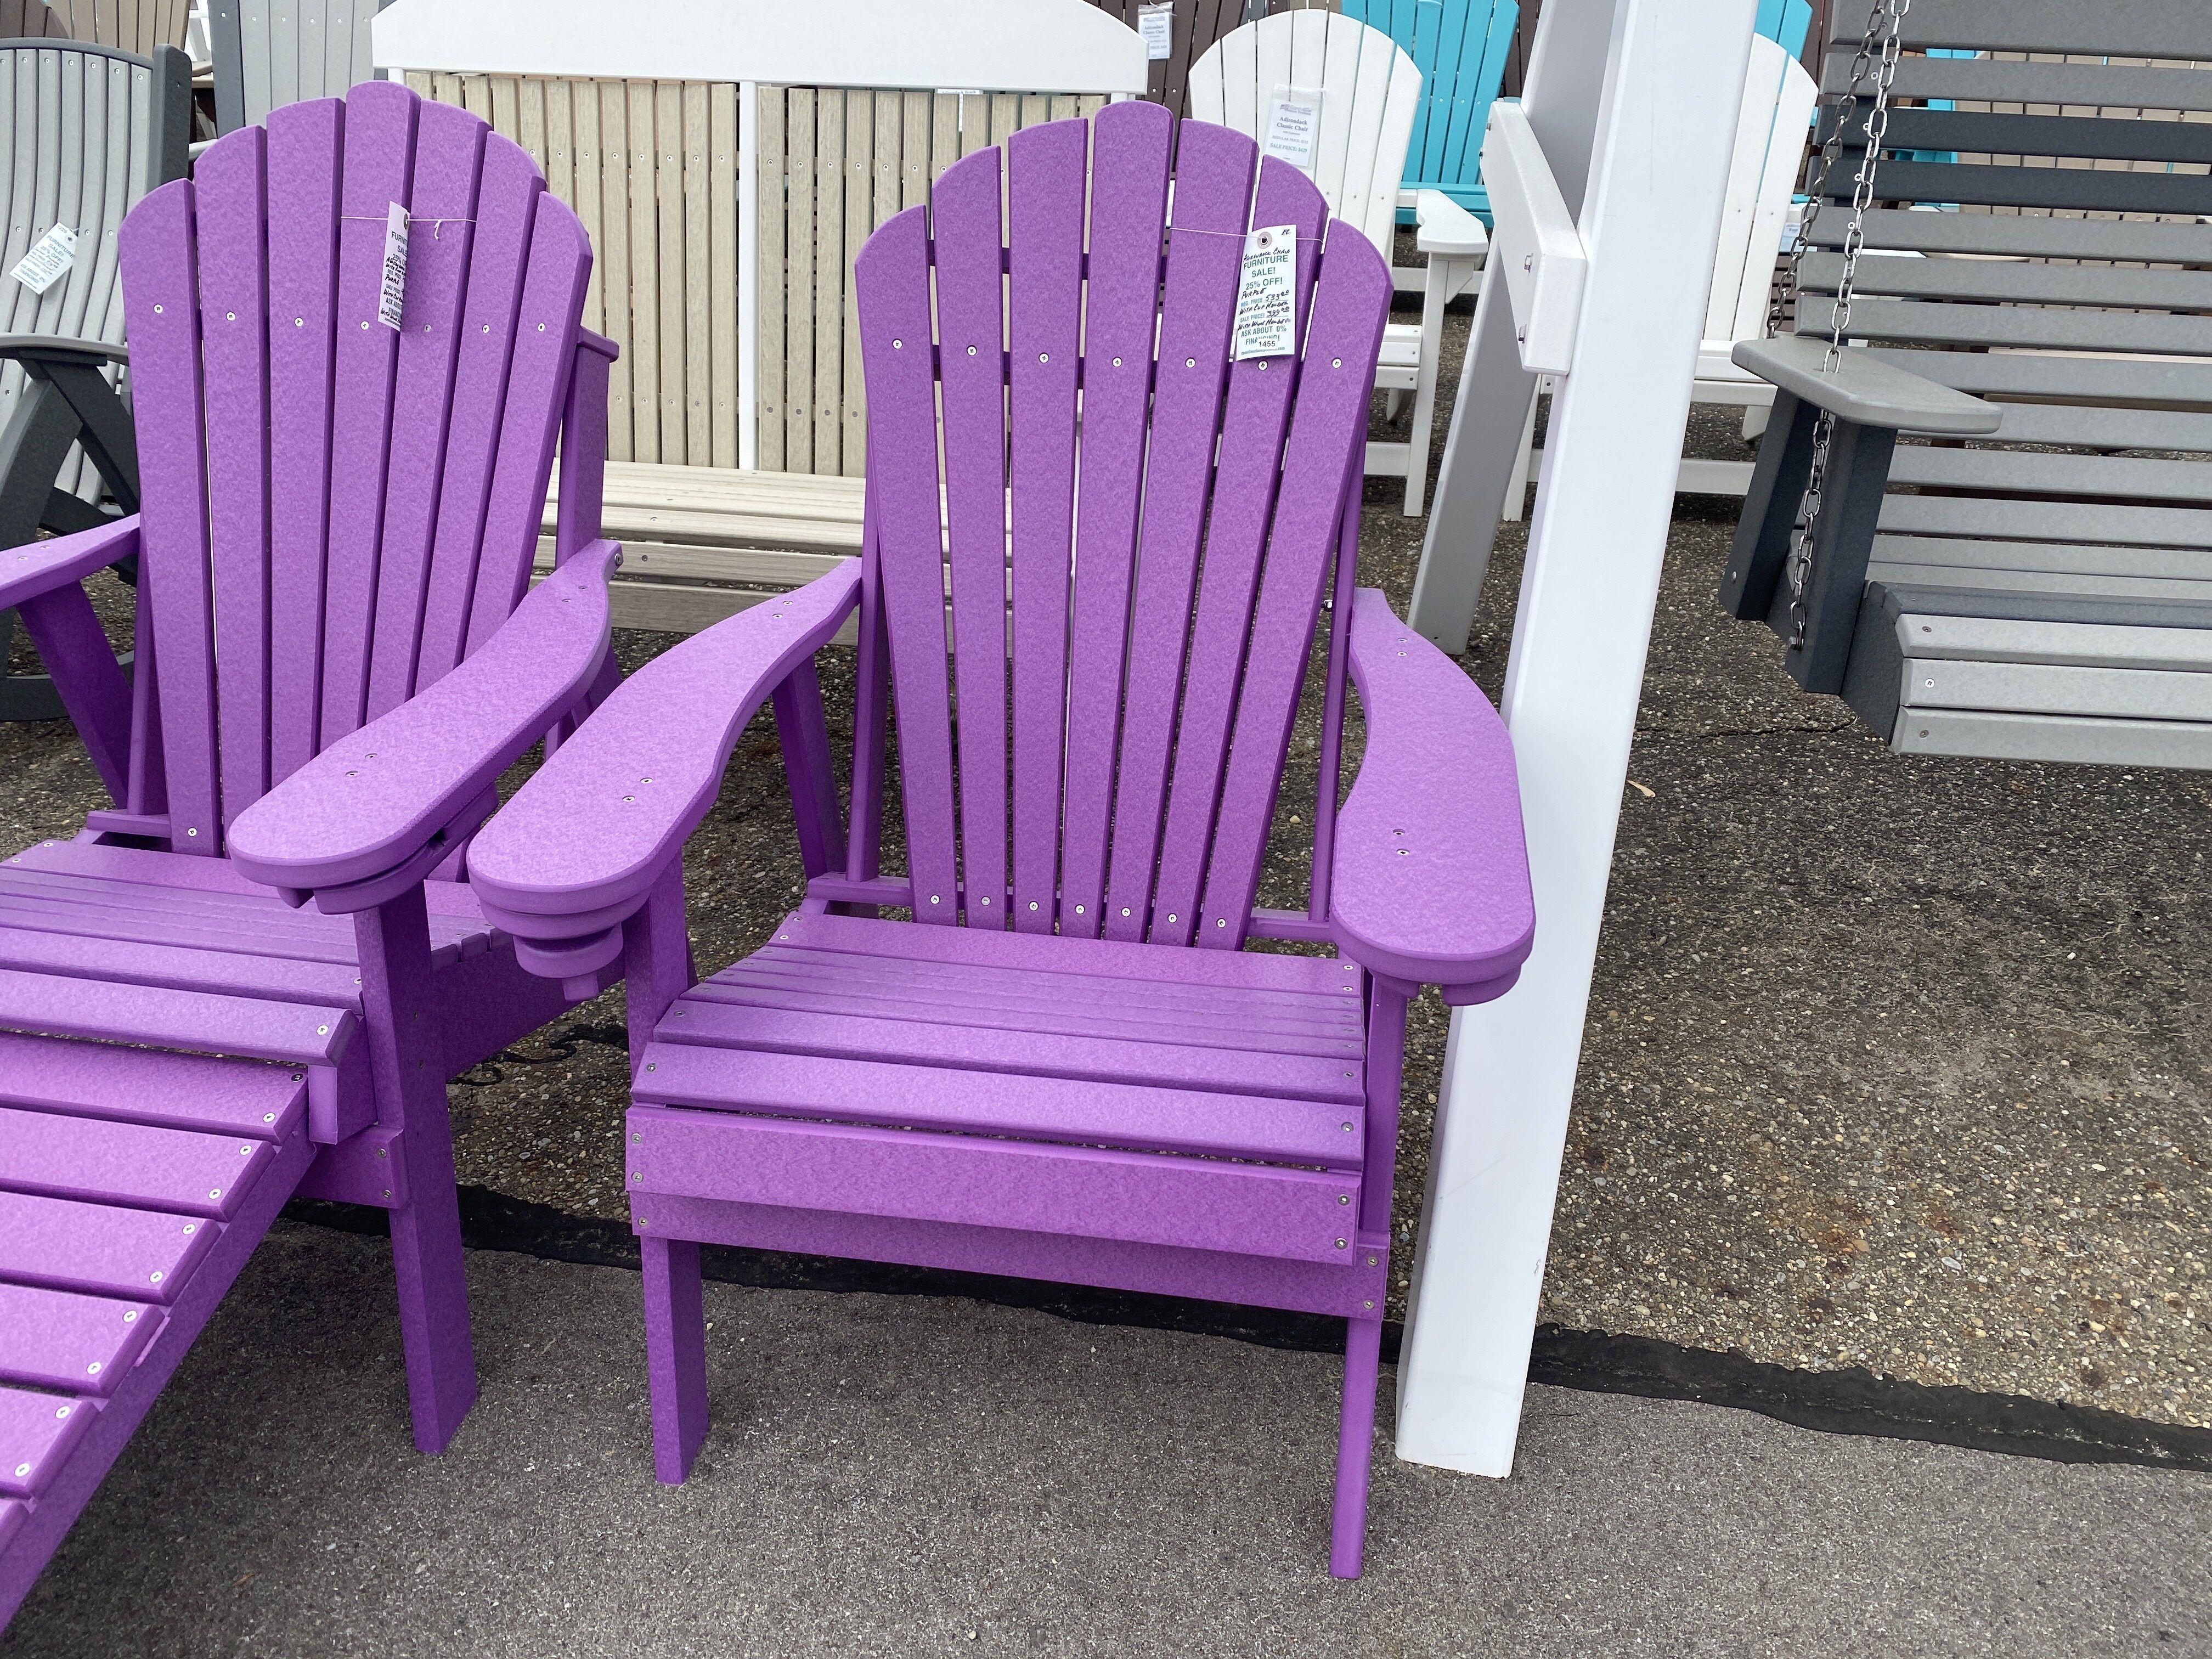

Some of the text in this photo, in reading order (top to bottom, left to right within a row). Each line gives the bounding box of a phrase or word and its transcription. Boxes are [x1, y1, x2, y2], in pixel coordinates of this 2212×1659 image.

[1279, 116, 1307, 125] Adirondack
[47, 235, 75, 259] FURNITURE
[48, 244, 64, 256] SALE!
[40, 245, 50, 254] 25%
[51, 253, 64, 263] OFF!
[392, 253, 401, 264] 25%
[1243, 255, 1289, 270] FURNITURE
[1251, 267, 1276, 278] SALE!
[1246, 277, 1283, 290] 25% OFF!
[1252, 326, 1273, 335] ABOUT
